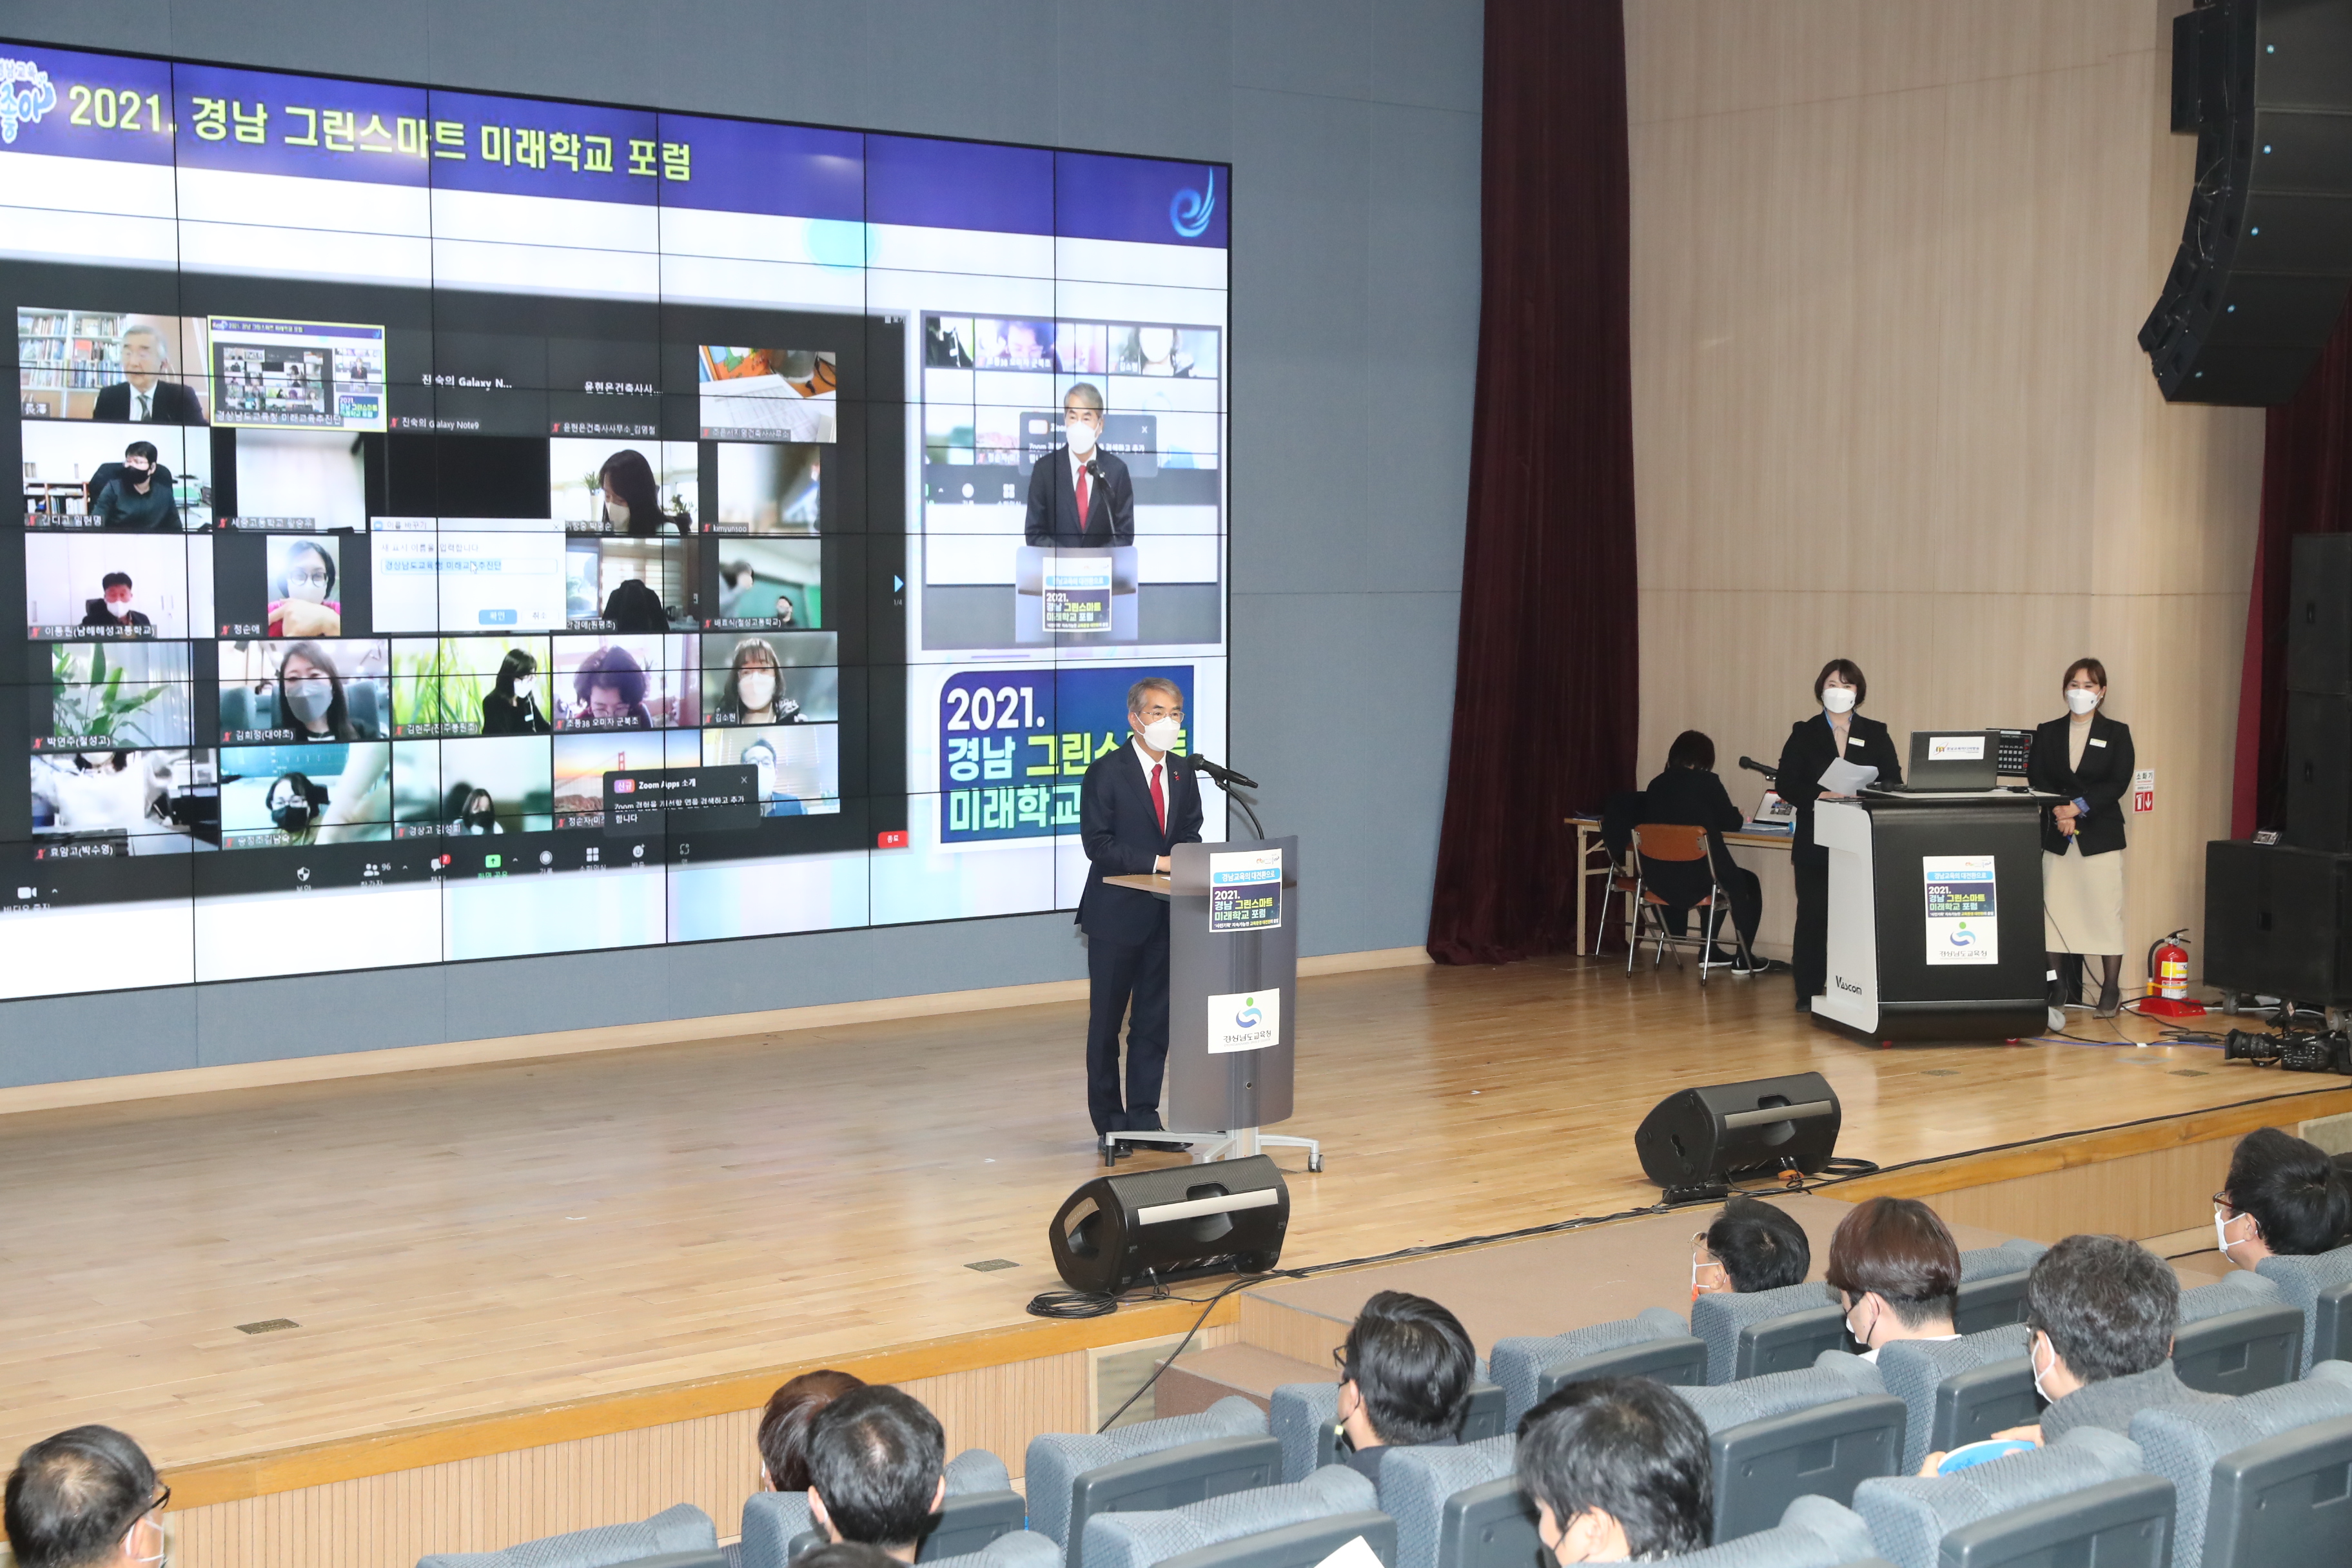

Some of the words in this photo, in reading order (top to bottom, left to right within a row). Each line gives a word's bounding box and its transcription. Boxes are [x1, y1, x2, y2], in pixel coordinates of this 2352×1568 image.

[70, 84, 177, 133] 2021.
[192, 97, 268, 144] 경남
[284, 105, 466, 160] 그린스마트
[481, 125, 612, 173] 미래학교
[628, 139, 690, 181] 포럼
[458, 377, 492, 392] Galaxy
[495, 378, 513, 389] N...
[429, 420, 455, 431] Galaxy
[456, 421, 480, 430] Note9
[712, 521, 747, 532] kimyunsoo
[1046, 593, 1069, 602] 2021.
[946, 686, 1045, 731] 2021.
[592, 717, 614, 727] 오미자
[948, 735, 1016, 782] 경남
[618, 780, 632, 791] 신규
[638, 781, 660, 790] Zoom
[661, 779, 680, 790] Apps
[682, 778, 696, 788] 소개
[381, 863, 391, 871] 96
[1222, 871, 1251, 882] 경남교육의
[1251, 870, 1276, 880] 대전환으로
[1214, 890, 1240, 900] 2021.
[1928, 886, 1952, 894] 2021.
[1214, 900, 1233, 910] 경남
[1235, 897, 1273, 909] 그린스마트
[1929, 894, 1945, 903] 경남
[1946, 894, 1986, 903] 그린스마트
[1930, 903, 1961, 911] 미래학교
[1962, 903, 1978, 911] 포럼
[1214, 910, 1250, 921] 미래학교
[1251, 908, 1266, 919] 포럼
[1835, 975, 1862, 995] Vascom
[1223, 1030, 1271, 1043] 경상남도교육청
